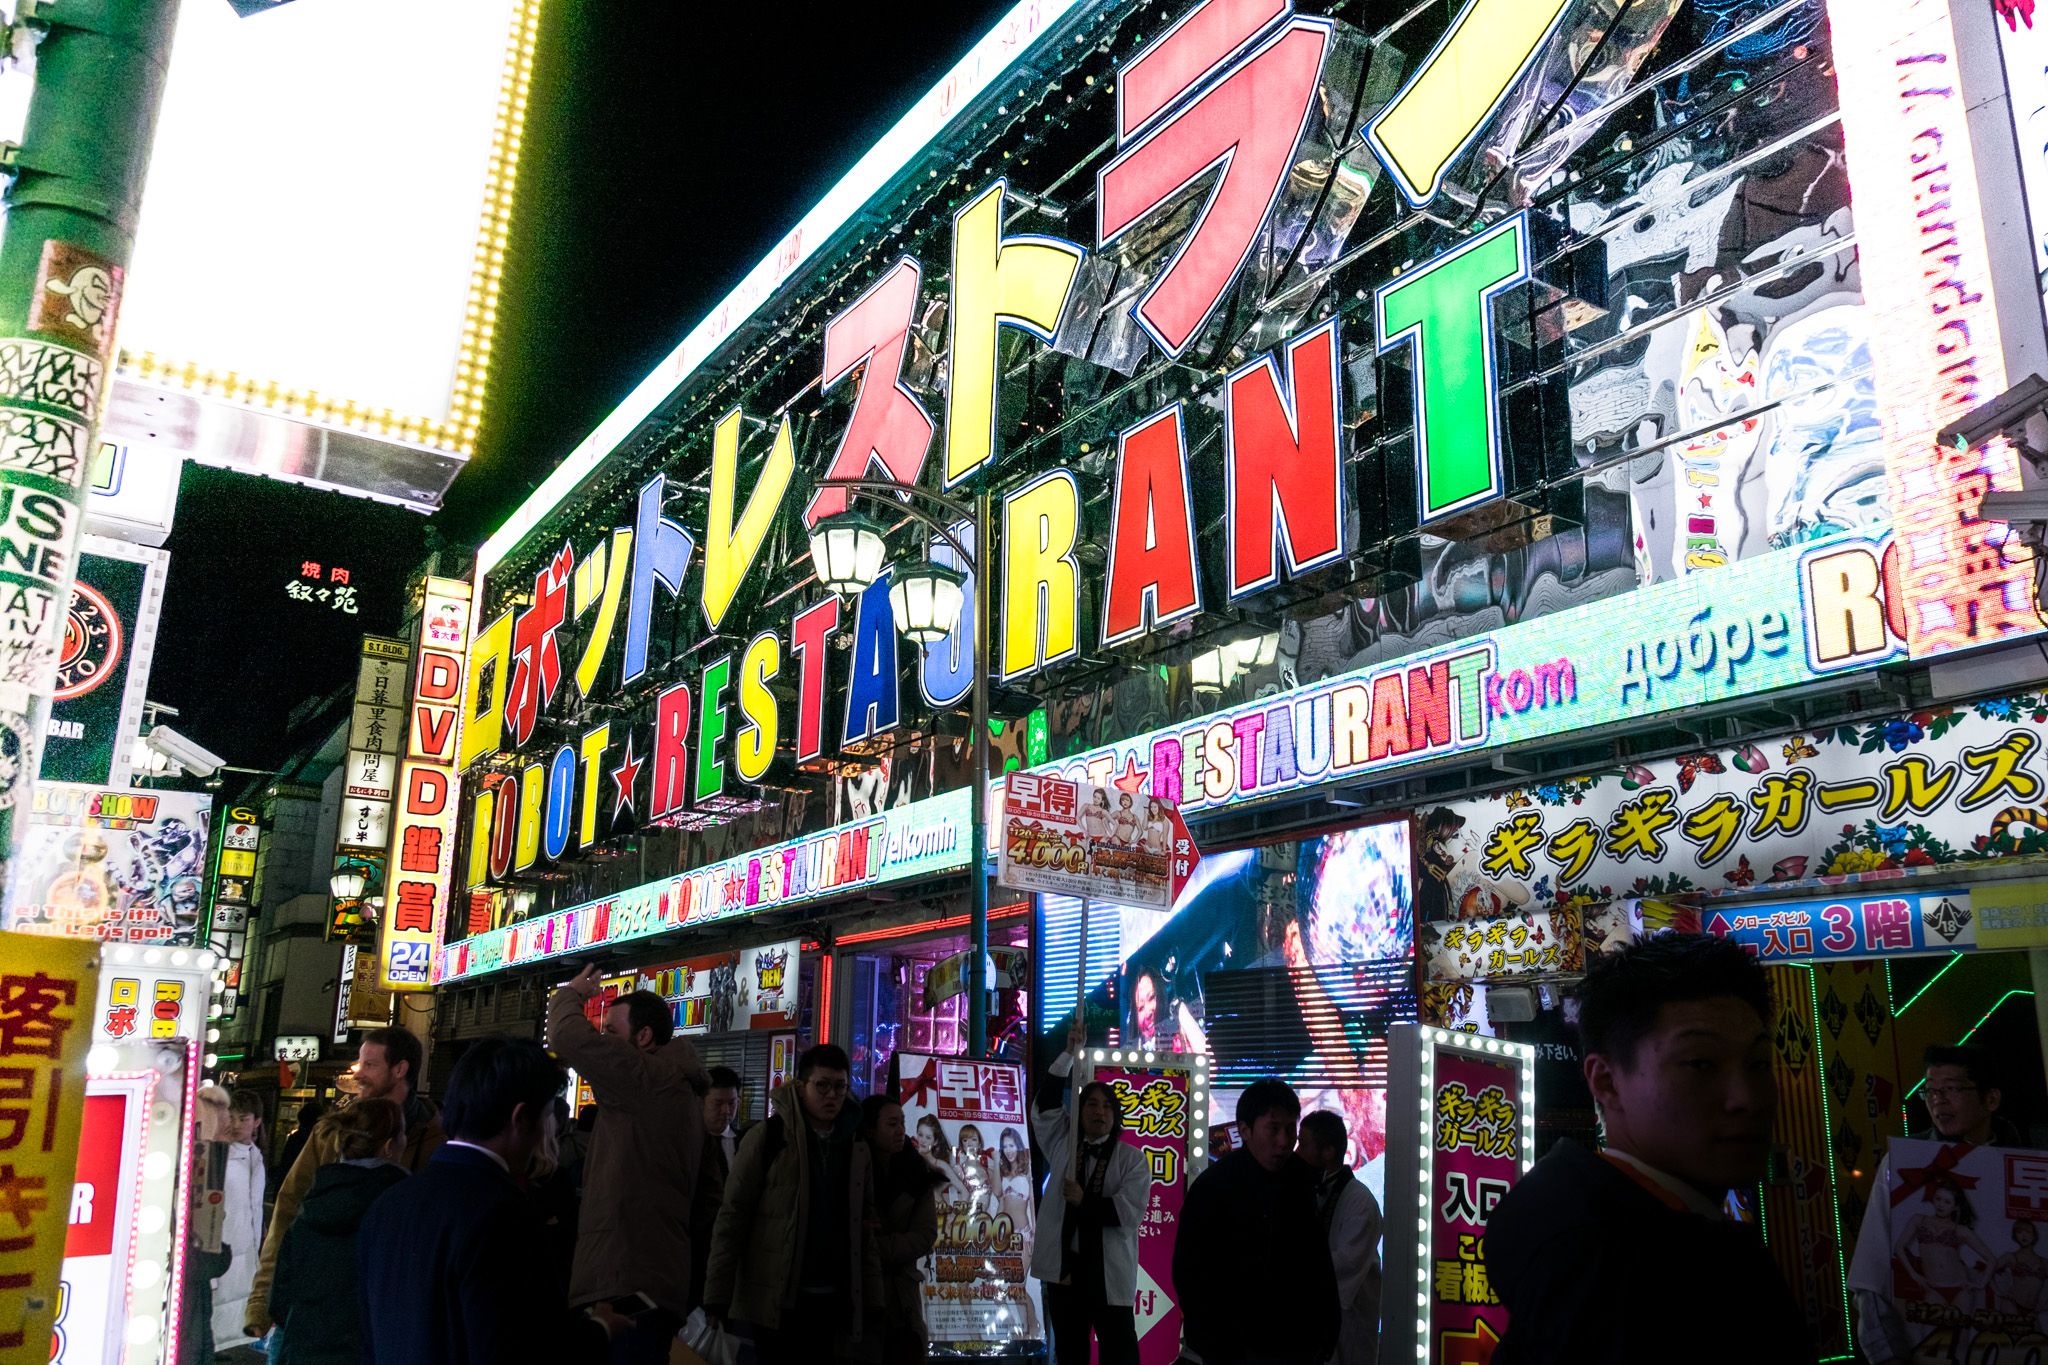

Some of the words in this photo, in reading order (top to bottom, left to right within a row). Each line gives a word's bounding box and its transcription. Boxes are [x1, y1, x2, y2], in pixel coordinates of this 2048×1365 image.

[466, 721, 611, 892] ROBOT
[650, 210, 1532, 822] RESTAURANT
[301, 560, 350, 585] 焼肉
[285, 579, 359, 615] 叙々苑
[361, 675, 389, 784] 日暮里食肉問屋
[1150, 648, 1490, 806] RESTAURANT
[88, 792, 158, 820] SHOW
[396, 652, 458, 934] DVD鑑賞
[1006, 774, 1078, 817] 早得
[1483, 731, 2041, 884] ギラギラガールズ
[666, 867, 725, 928] ROBOT
[745, 820, 884, 908] RESTAURANT
[1174, 837, 1191, 877] 受付
[103, 908, 123, 920] is
[1733, 911, 1810, 931] タローズビル
[1763, 926, 1815, 956] 入口
[1822, 899, 1914, 953] 3階
[129, 926, 173, 941] go!!
[1443, 921, 1529, 953] ギラギラ
[391, 942, 429, 971] 24
[1487, 945, 1562, 971] ガールズ
[389, 971, 427, 982] OPEN
[656, 965, 688, 1000] ROBOT
[761, 967, 782, 991] REN
[105, 977, 141, 1039] ロボ
[939, 1061, 1020, 1112] 早得
[1121, 1113, 1184, 1136] ールズ
[1437, 1086, 1516, 1128] ギラギラ
[1438, 1120, 1517, 1158] ガールズ
[1434, 1260, 1500, 1303] 看板
